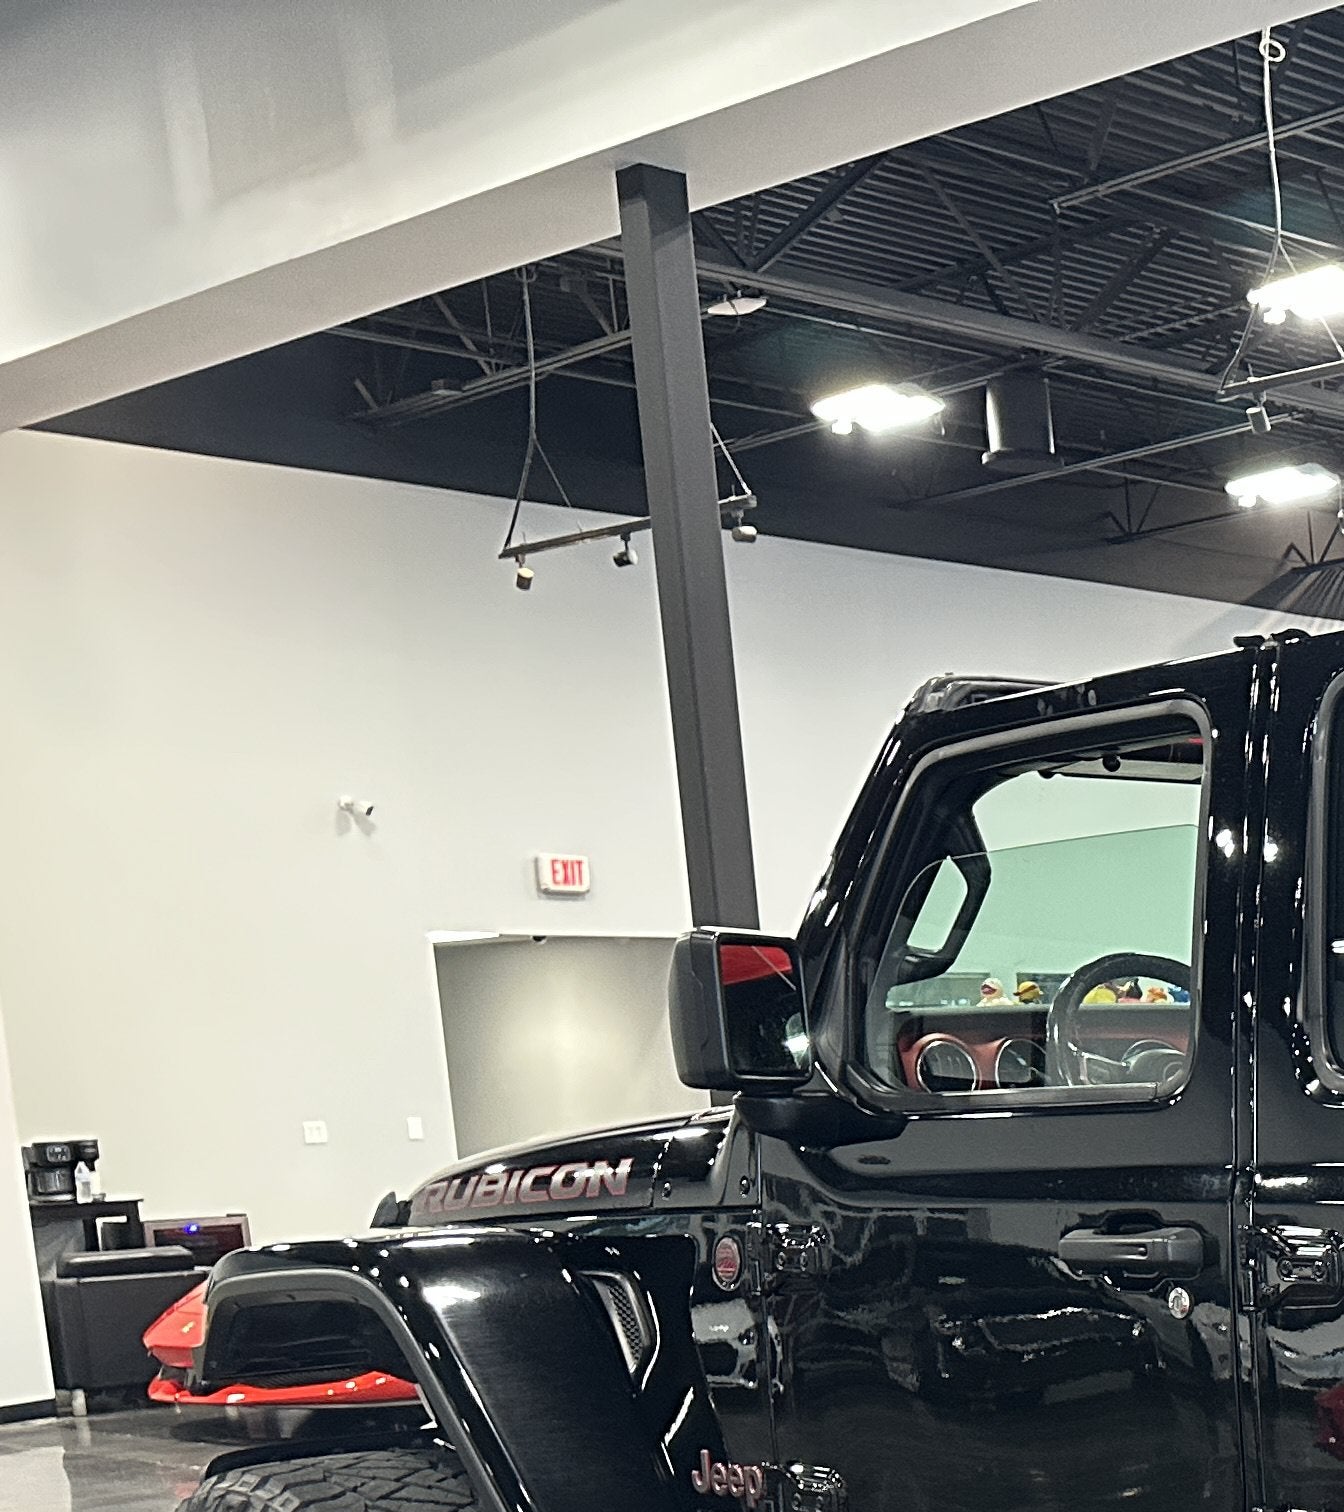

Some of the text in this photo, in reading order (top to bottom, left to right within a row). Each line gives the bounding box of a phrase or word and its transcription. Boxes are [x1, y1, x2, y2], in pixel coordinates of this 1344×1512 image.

[551, 858, 584, 886] EXIT
[419, 1157, 635, 1214] RUBICON
[691, 1449, 765, 1509] Jeep
